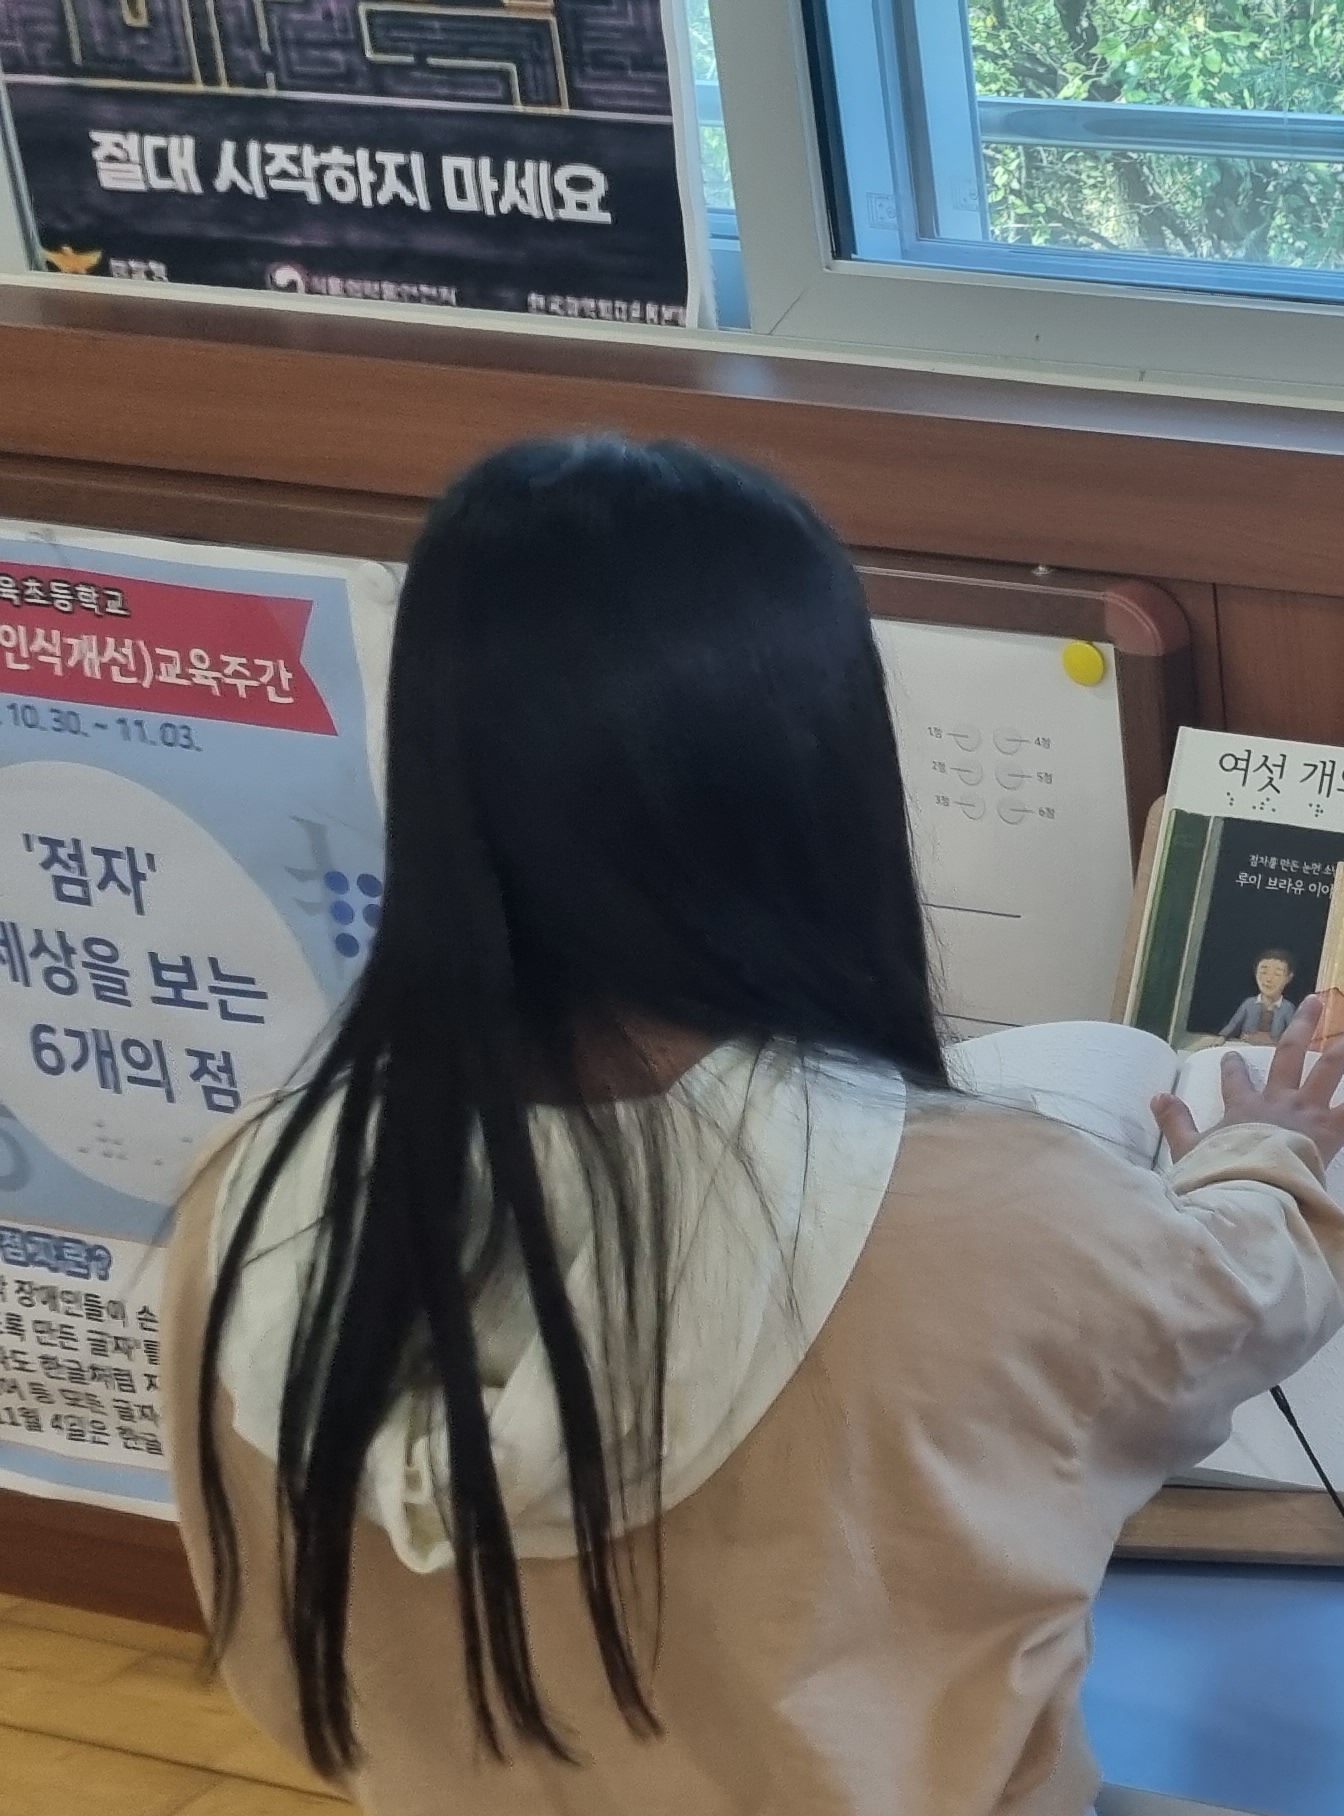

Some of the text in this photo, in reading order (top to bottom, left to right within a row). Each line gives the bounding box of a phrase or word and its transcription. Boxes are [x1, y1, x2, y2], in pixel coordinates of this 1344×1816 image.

[89, 129, 613, 224] 절대 시작하지 마세요
[0, 622, 294, 705] 인식개선)교육주간
[1219, 749, 1287, 795] 여섯
[22, 833, 157, 916] '점자'
[1235, 872, 1262, 890] 루이
[1265, 877, 1305, 896] 브라유
[1249, 854, 1278, 870] 점자를
[1280, 858, 1301, 873] 만든
[1302, 861, 1321, 876] 눈먼
[148, 951, 269, 1025] 보는
[30, 1023, 242, 1114] 6개의 점
[0, 1274, 127, 1329] 장애인들이
[32, 1319, 79, 1351] 만든
